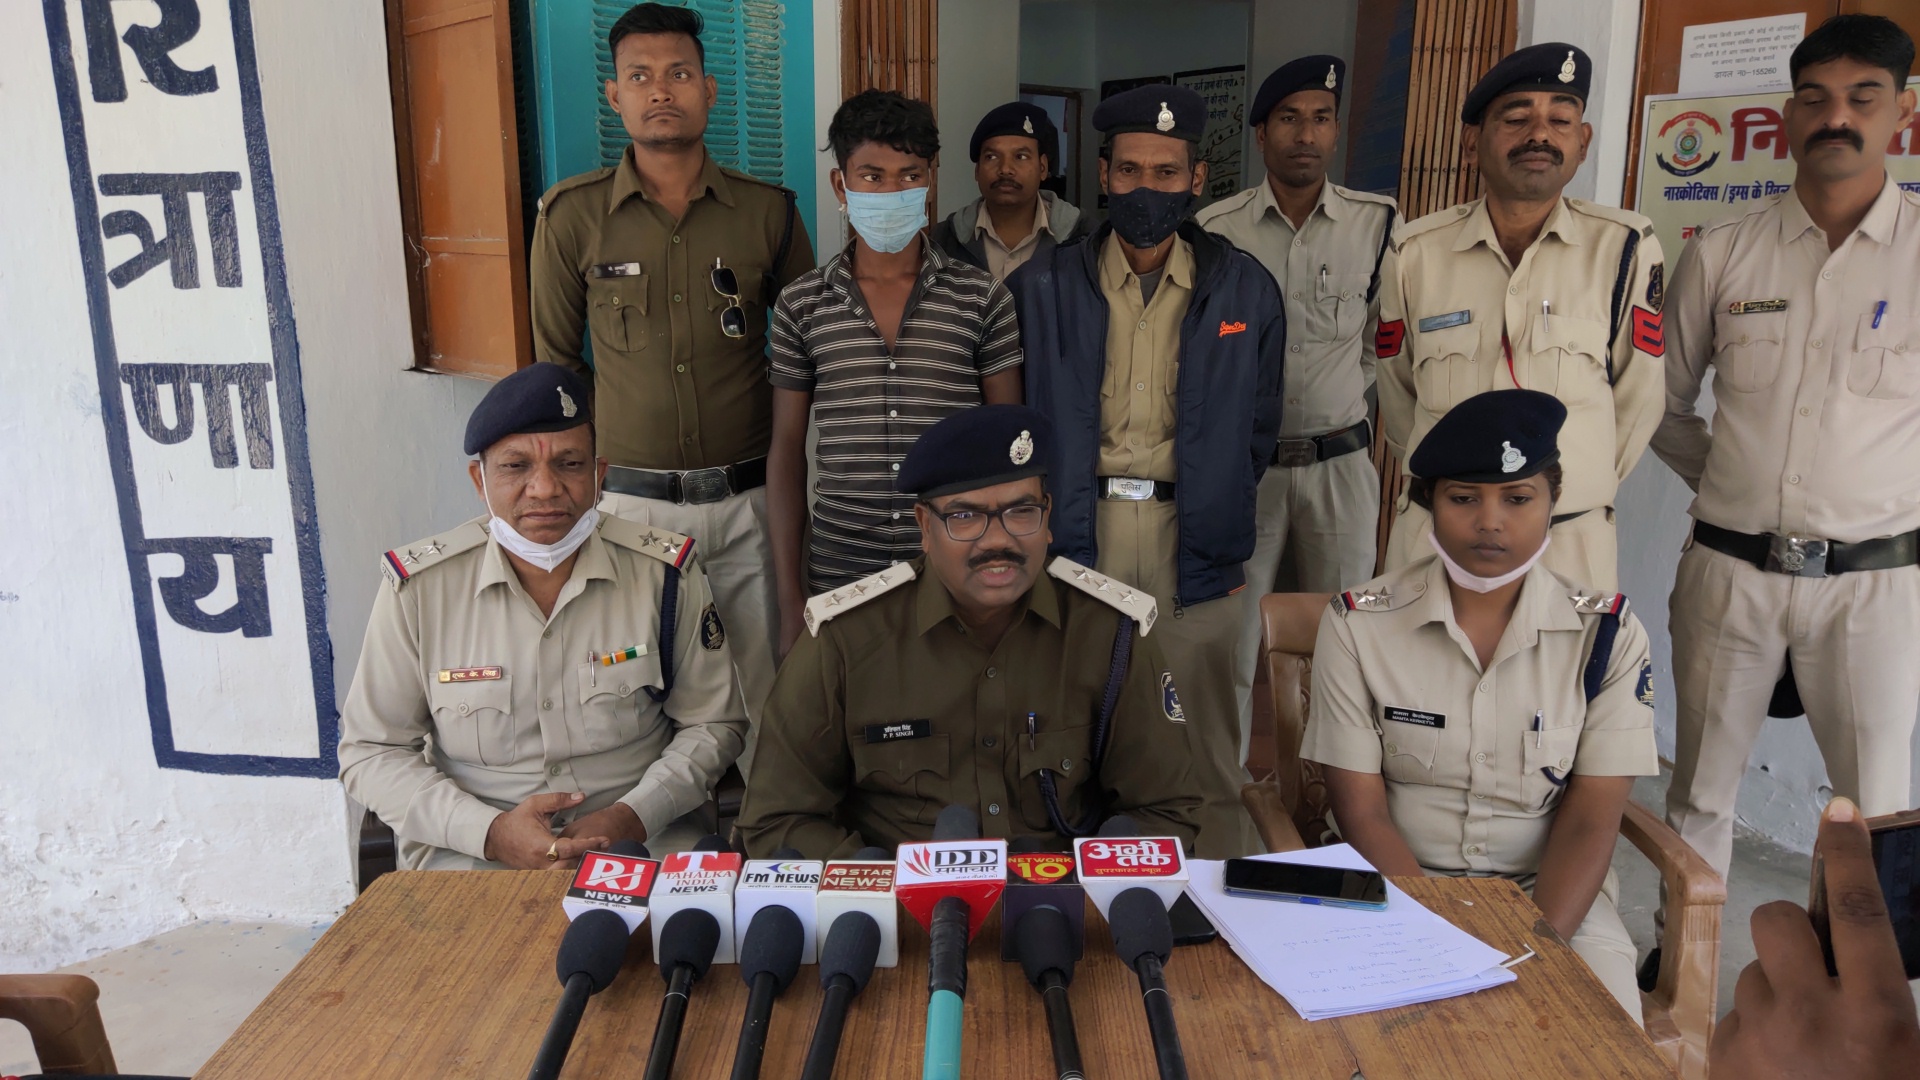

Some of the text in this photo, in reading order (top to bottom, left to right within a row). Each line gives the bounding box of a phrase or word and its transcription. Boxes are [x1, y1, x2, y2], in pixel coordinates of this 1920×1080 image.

[1752, 180, 1763, 200] के
[1120, 482, 1142, 494] पुलिस
[1087, 840, 1161, 860] अभी
[936, 850, 998, 866] DD
[1116, 854, 1172, 866] तक
[585, 858, 646, 891] RJ
[664, 870, 732, 880] TAHALKA
[848, 868, 892, 876] STAR
[935, 866, 998, 874] समाचार
[1018, 862, 1068, 878] 10
[676, 878, 716, 886] INDIA
[745, 873, 820, 884] FM NEWS
[822, 878, 892, 887] NEWS
[669, 884, 718, 894] NEWS
[584, 890, 633, 904] NEWS
